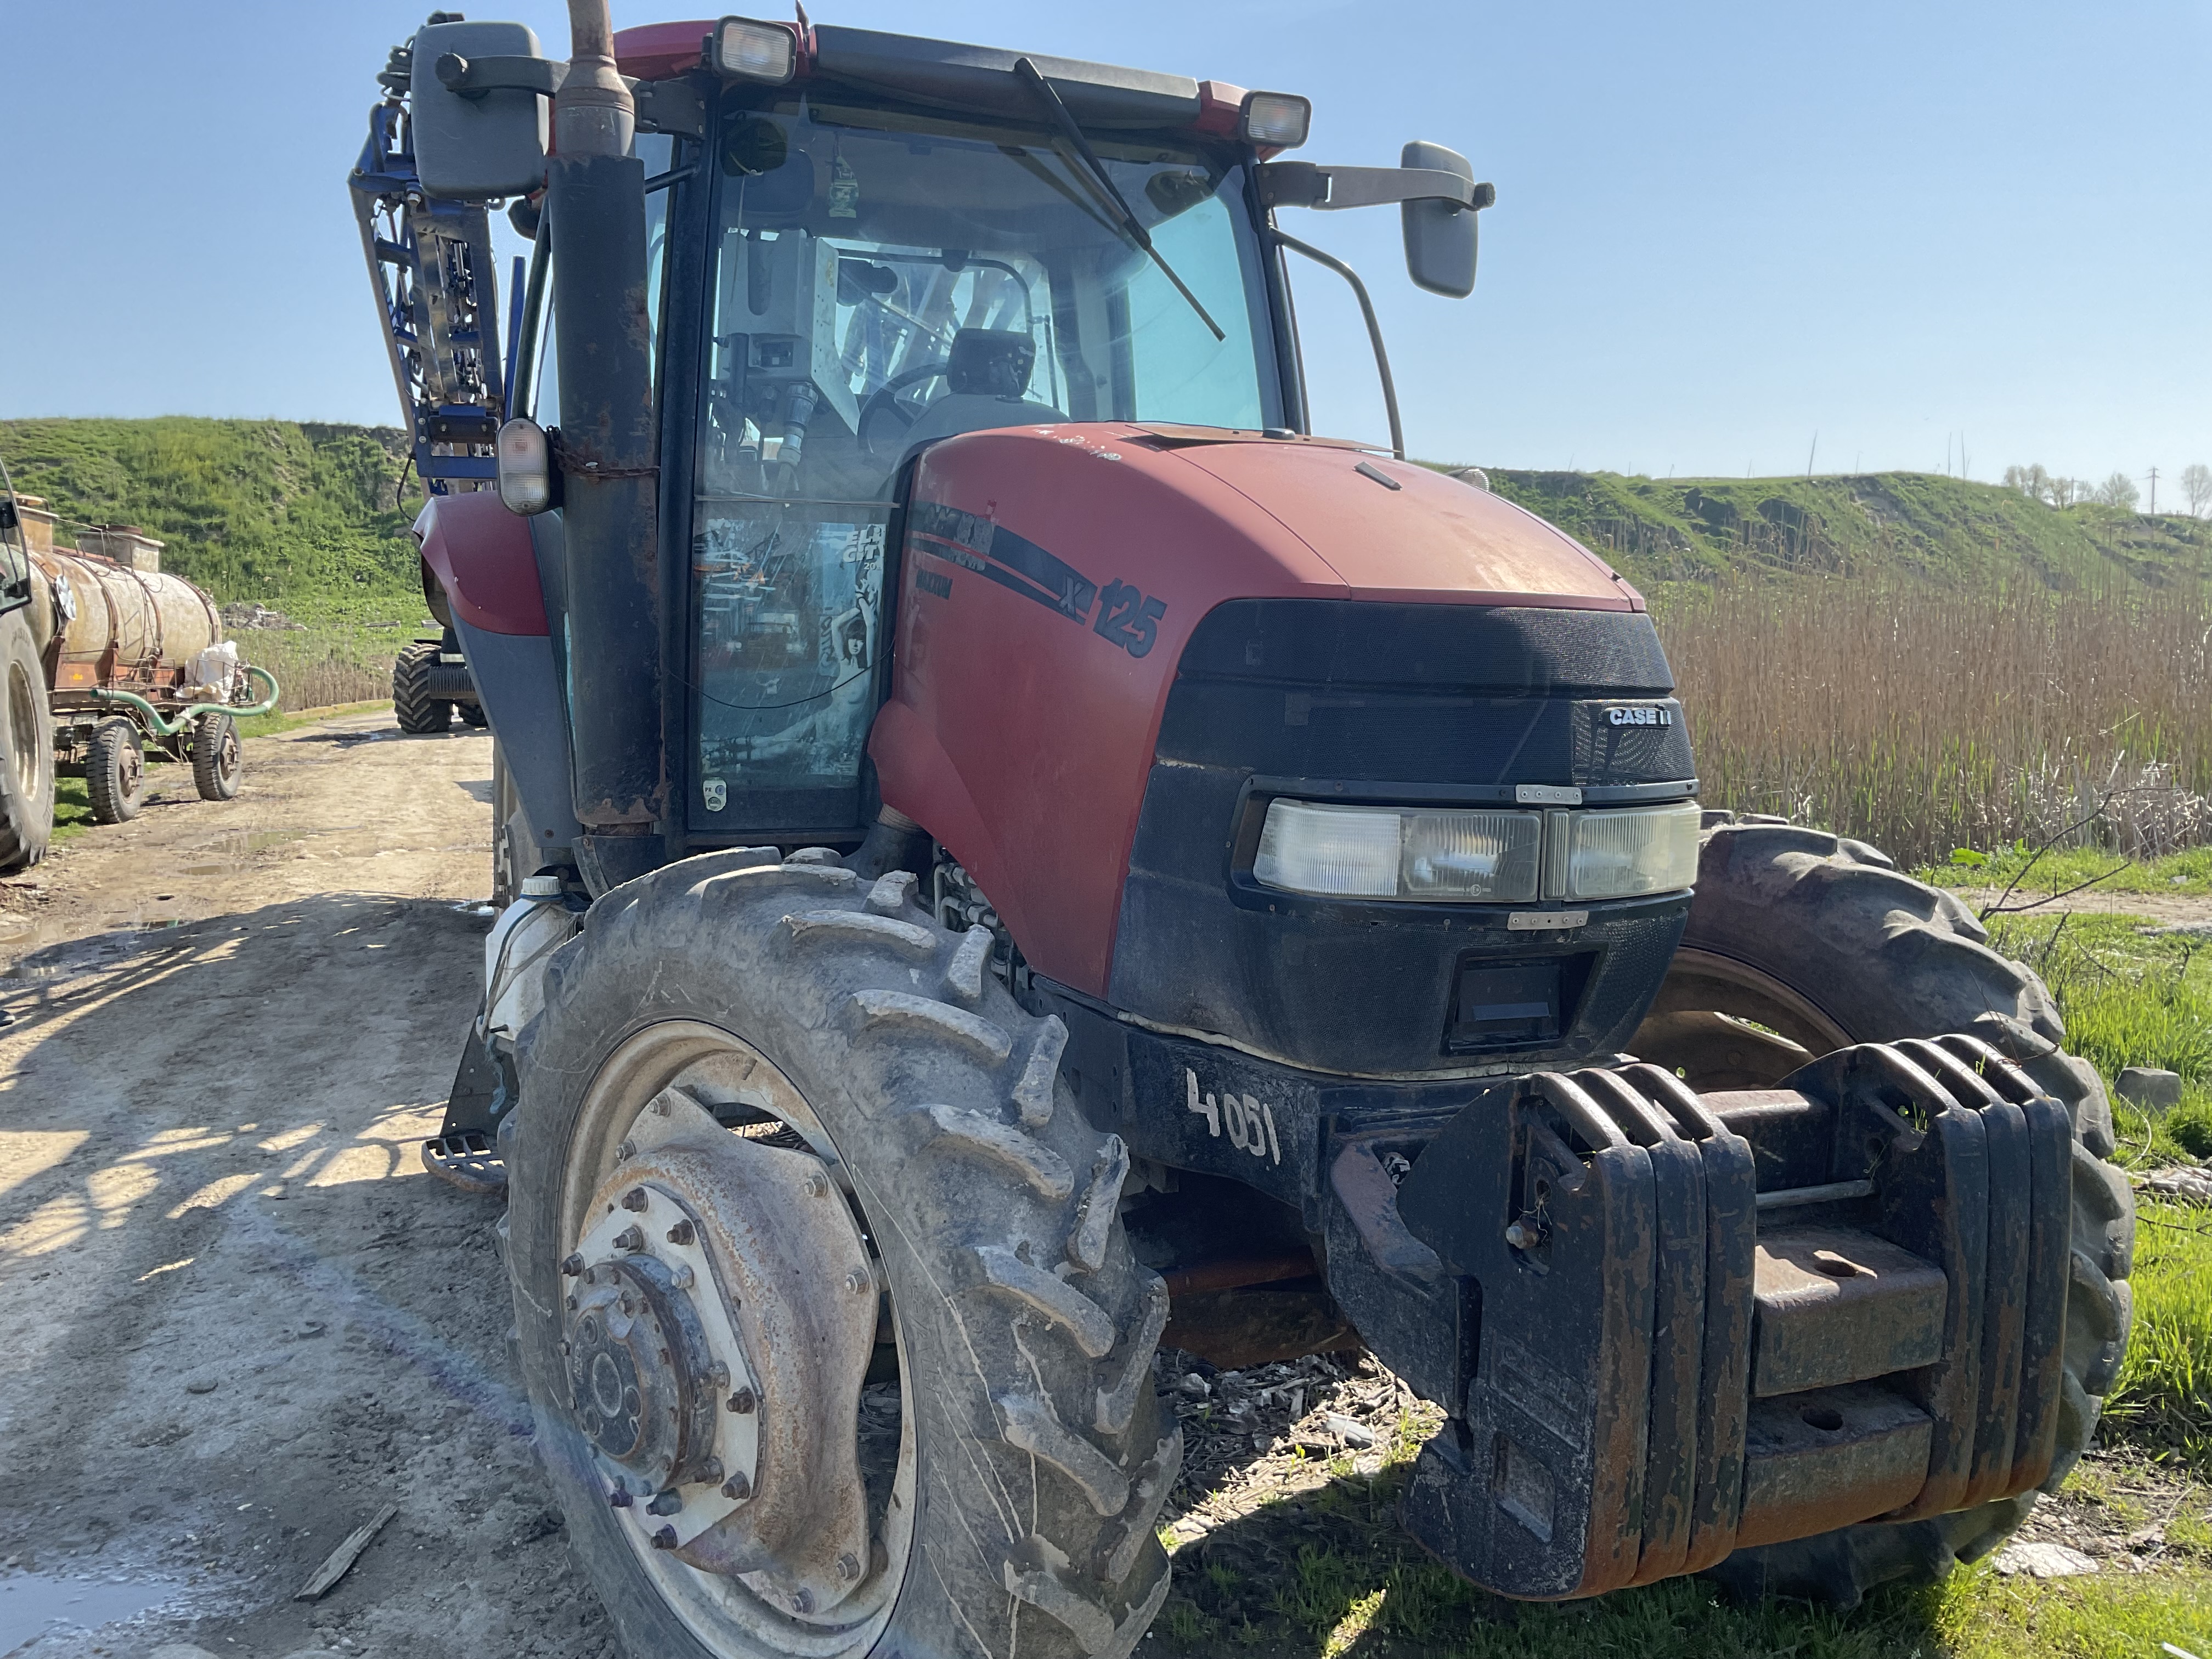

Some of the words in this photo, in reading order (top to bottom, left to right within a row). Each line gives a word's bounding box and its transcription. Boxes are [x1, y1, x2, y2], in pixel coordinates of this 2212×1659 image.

[1093, 578, 1167, 658] 125
[1610, 709, 1657, 725] CASE
[1186, 1068, 1281, 1165] 4051
